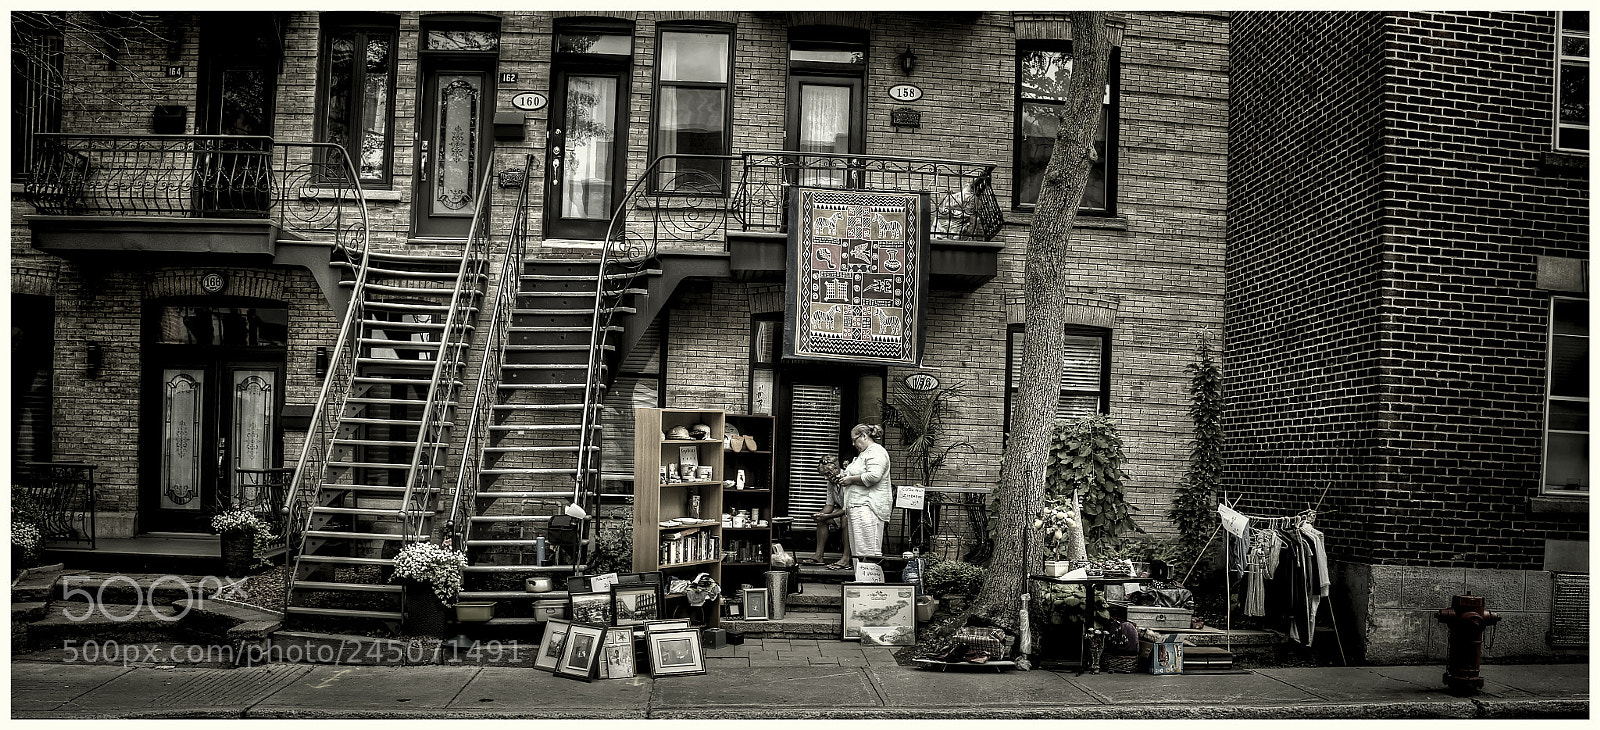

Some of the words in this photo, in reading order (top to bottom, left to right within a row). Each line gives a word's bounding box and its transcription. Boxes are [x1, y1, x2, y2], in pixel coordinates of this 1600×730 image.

[169, 67, 181, 76] 164
[503, 73, 516, 82] 162
[897, 87, 915, 98] 158
[520, 96, 540, 106] 160
